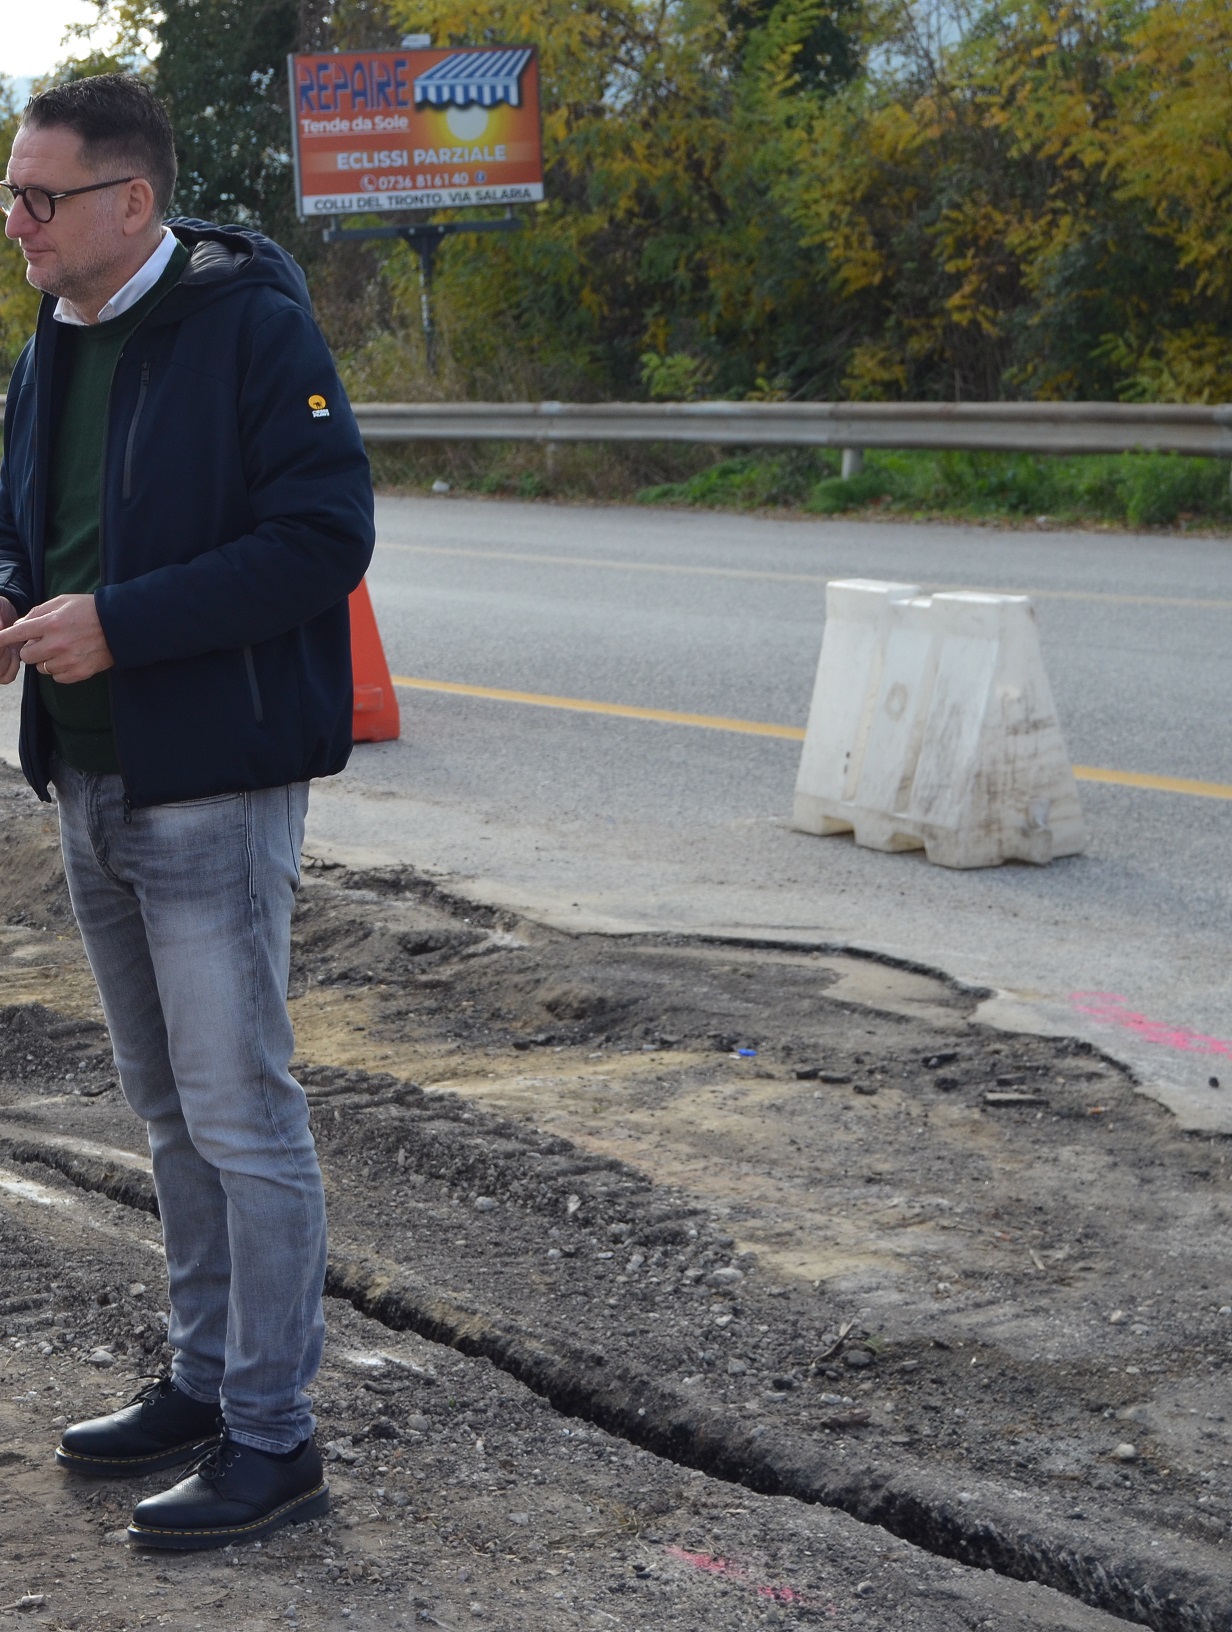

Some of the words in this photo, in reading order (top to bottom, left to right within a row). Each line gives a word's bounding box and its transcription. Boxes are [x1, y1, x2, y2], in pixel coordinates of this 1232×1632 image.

[297, 60, 410, 114] REPAIRE
[301, 117, 350, 133] Tende
[352, 115, 372, 131] da
[374, 114, 408, 130] Sole
[337, 151, 408, 170] ECLISSI
[413, 144, 507, 166] PARZIALE
[378, 174, 412, 190] 0736
[314, 197, 352, 211] COLLI
[357, 194, 383, 208] DEL
[448, 188, 471, 203] VIA
[476, 186, 531, 202] SALARIA
